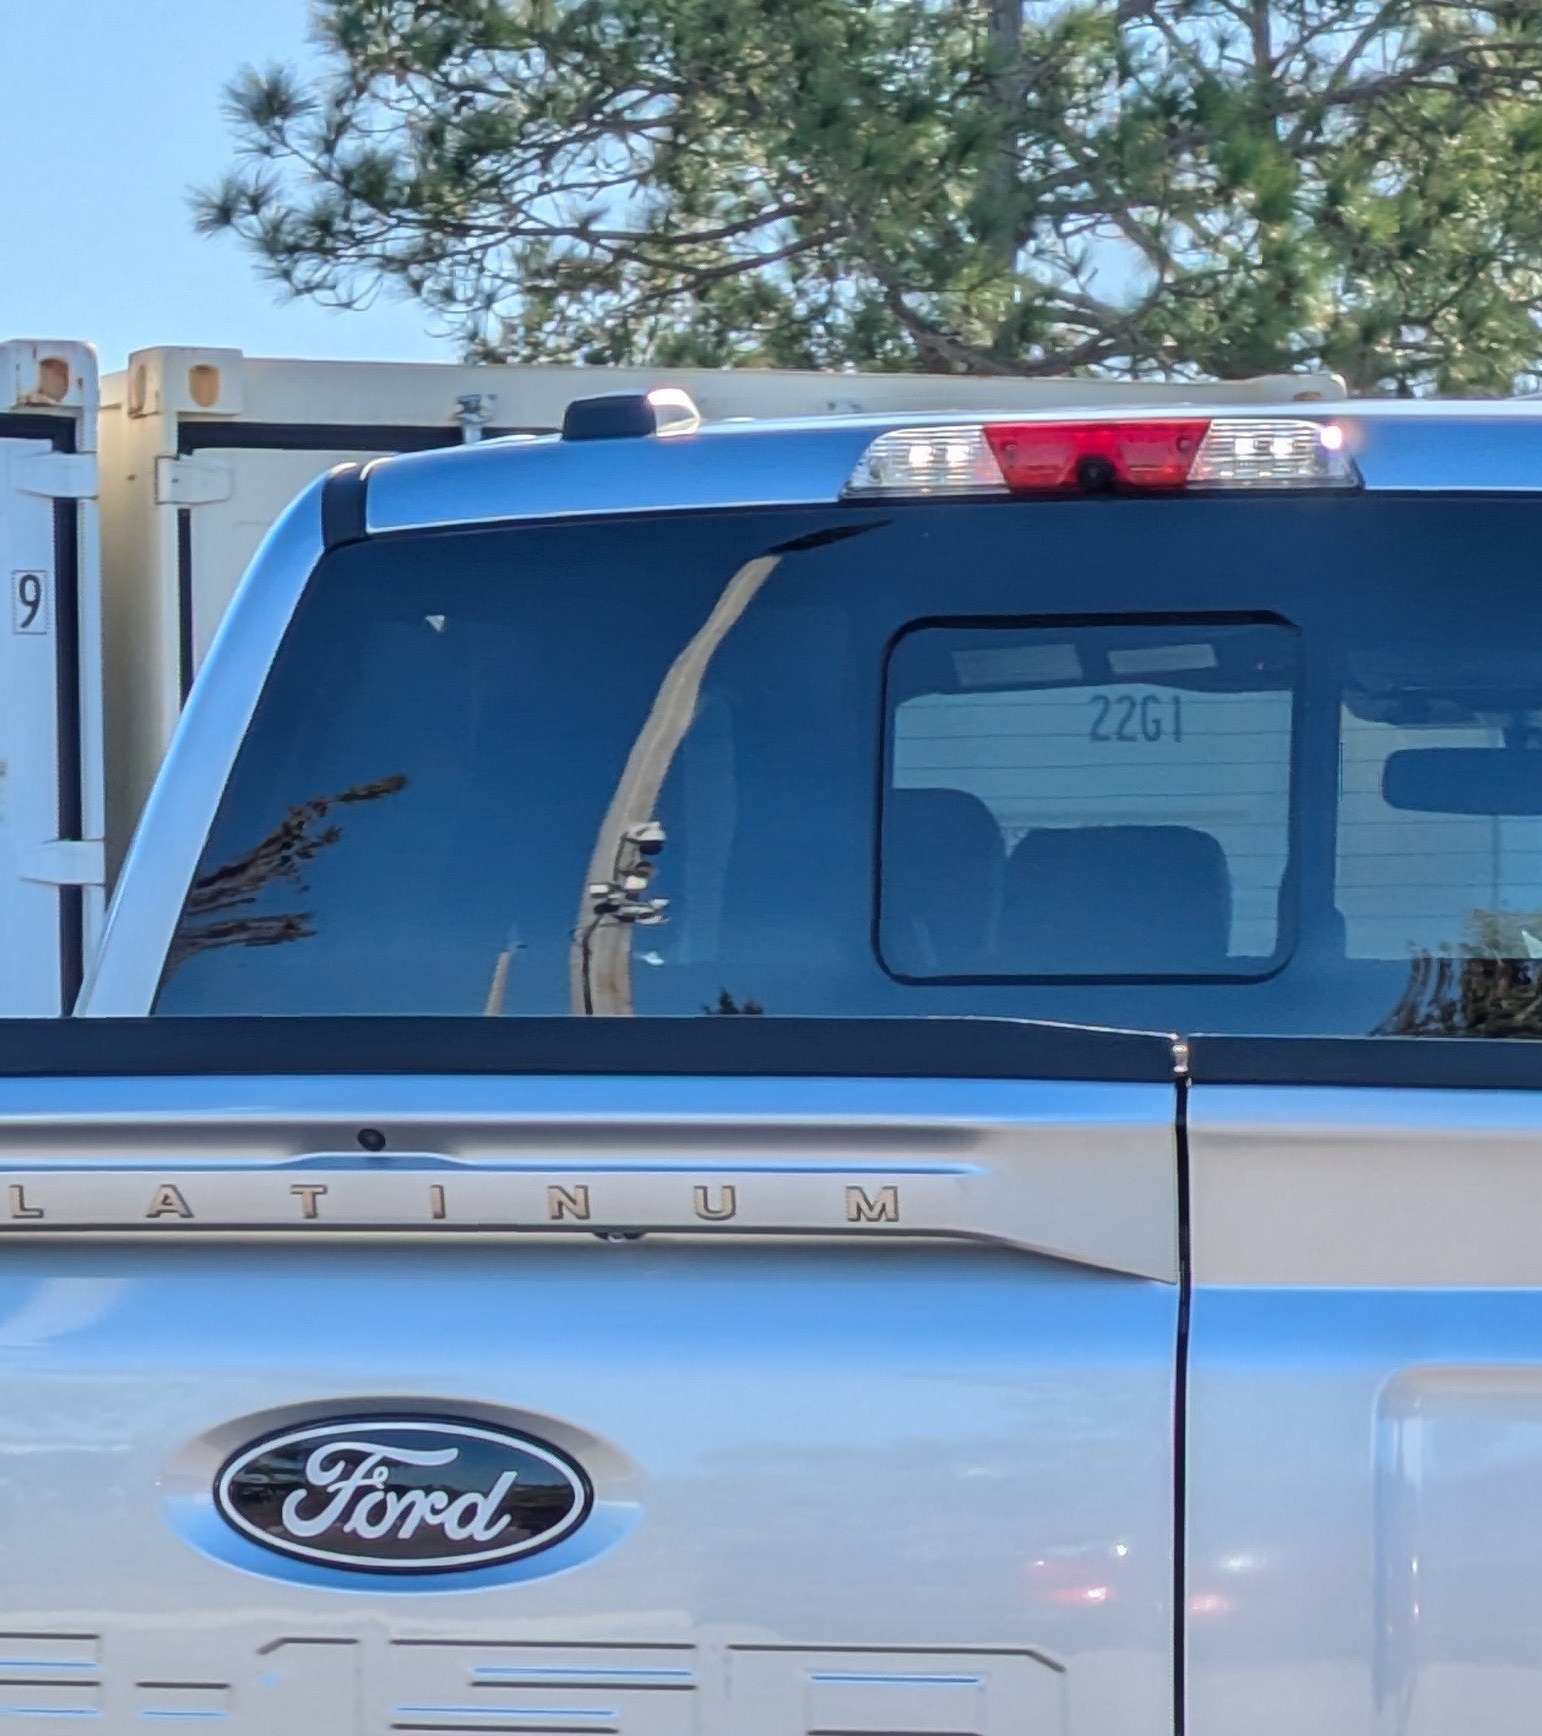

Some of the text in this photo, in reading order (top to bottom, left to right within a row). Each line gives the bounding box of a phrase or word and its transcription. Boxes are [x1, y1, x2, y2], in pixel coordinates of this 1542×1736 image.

[18, 573, 42, 629] 9
[1089, 694, 1182, 743] 22G1
[281, 1440, 519, 1542] Ford
